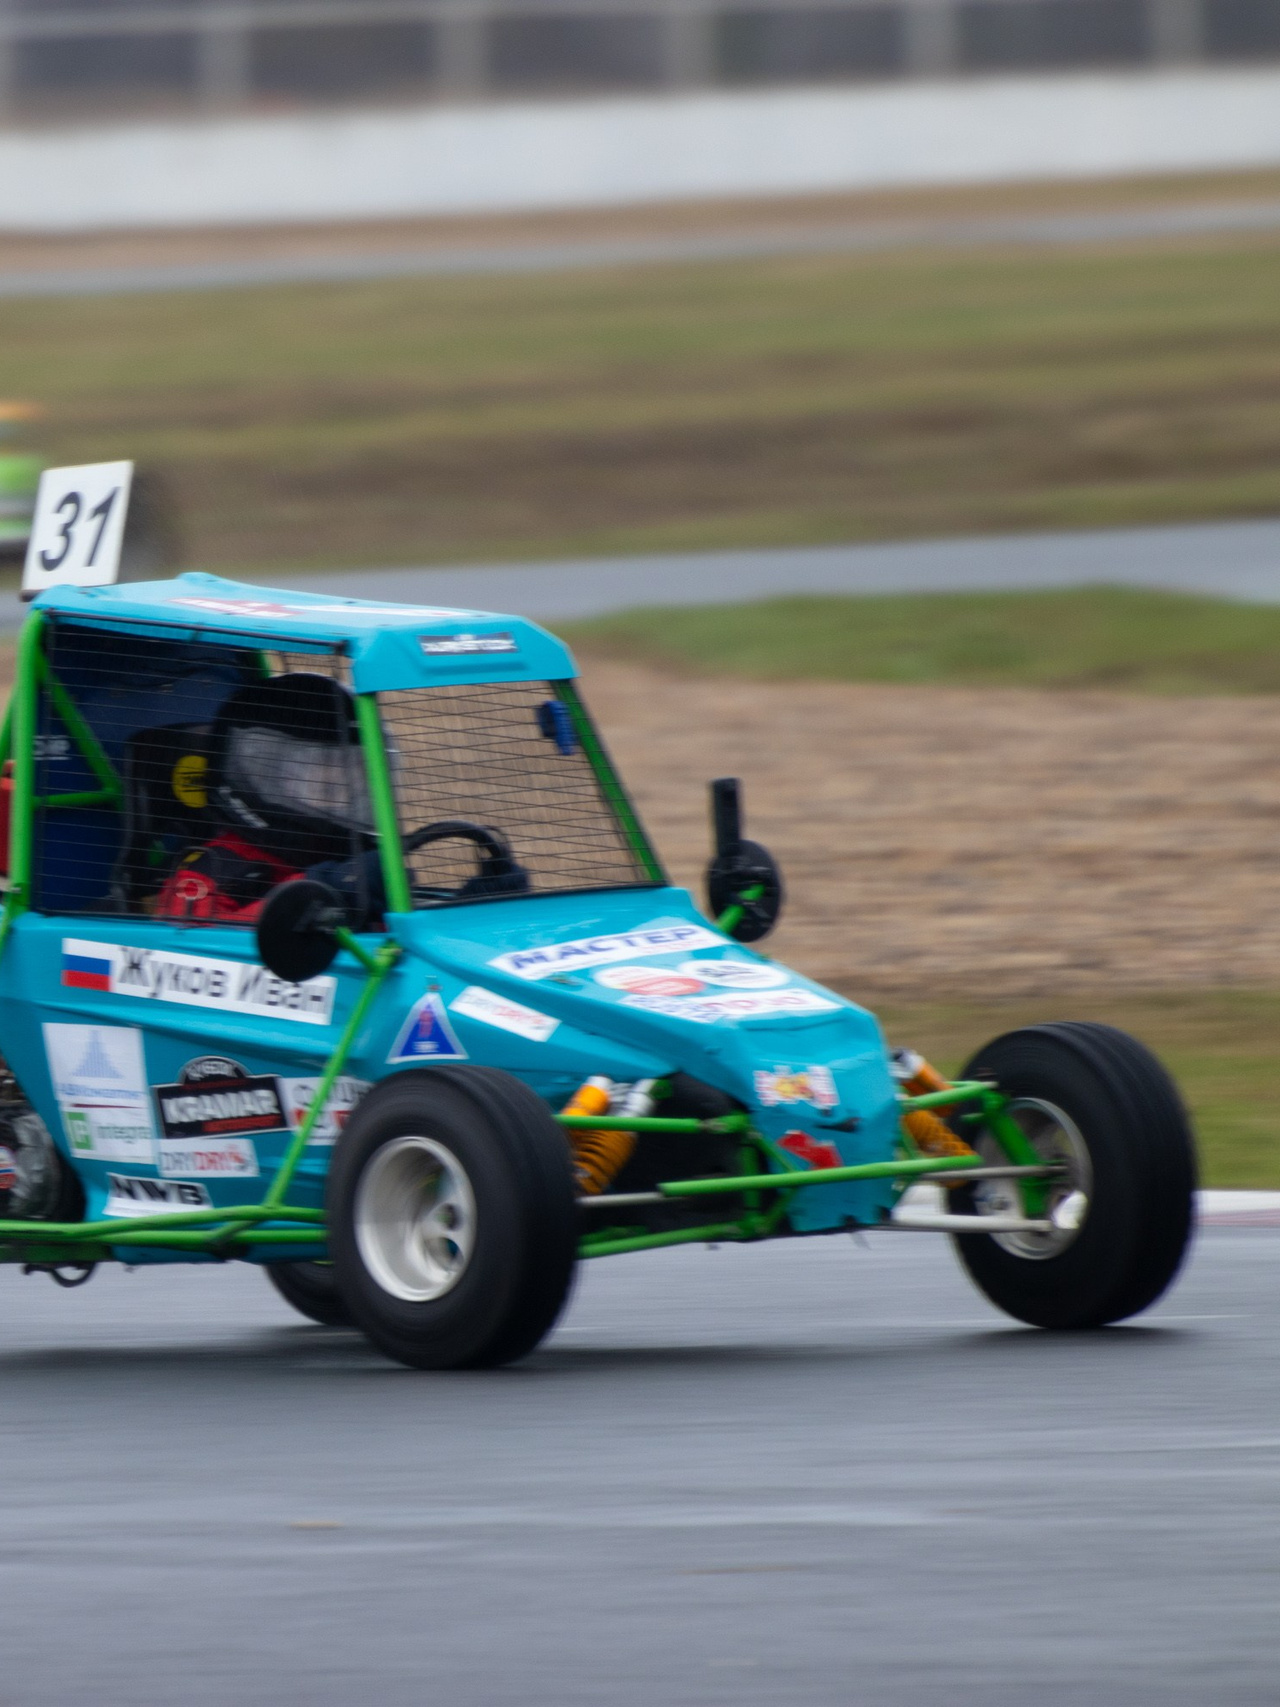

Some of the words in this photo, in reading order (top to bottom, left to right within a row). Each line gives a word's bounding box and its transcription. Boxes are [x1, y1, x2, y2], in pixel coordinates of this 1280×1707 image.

[37, 486, 124, 571] 31
[511, 927, 698, 970] МАСТЕР
[119, 945, 228, 998] Жуков
[161, 1089, 281, 1124] KRAMAR
[110, 1179, 205, 1206] NWB
